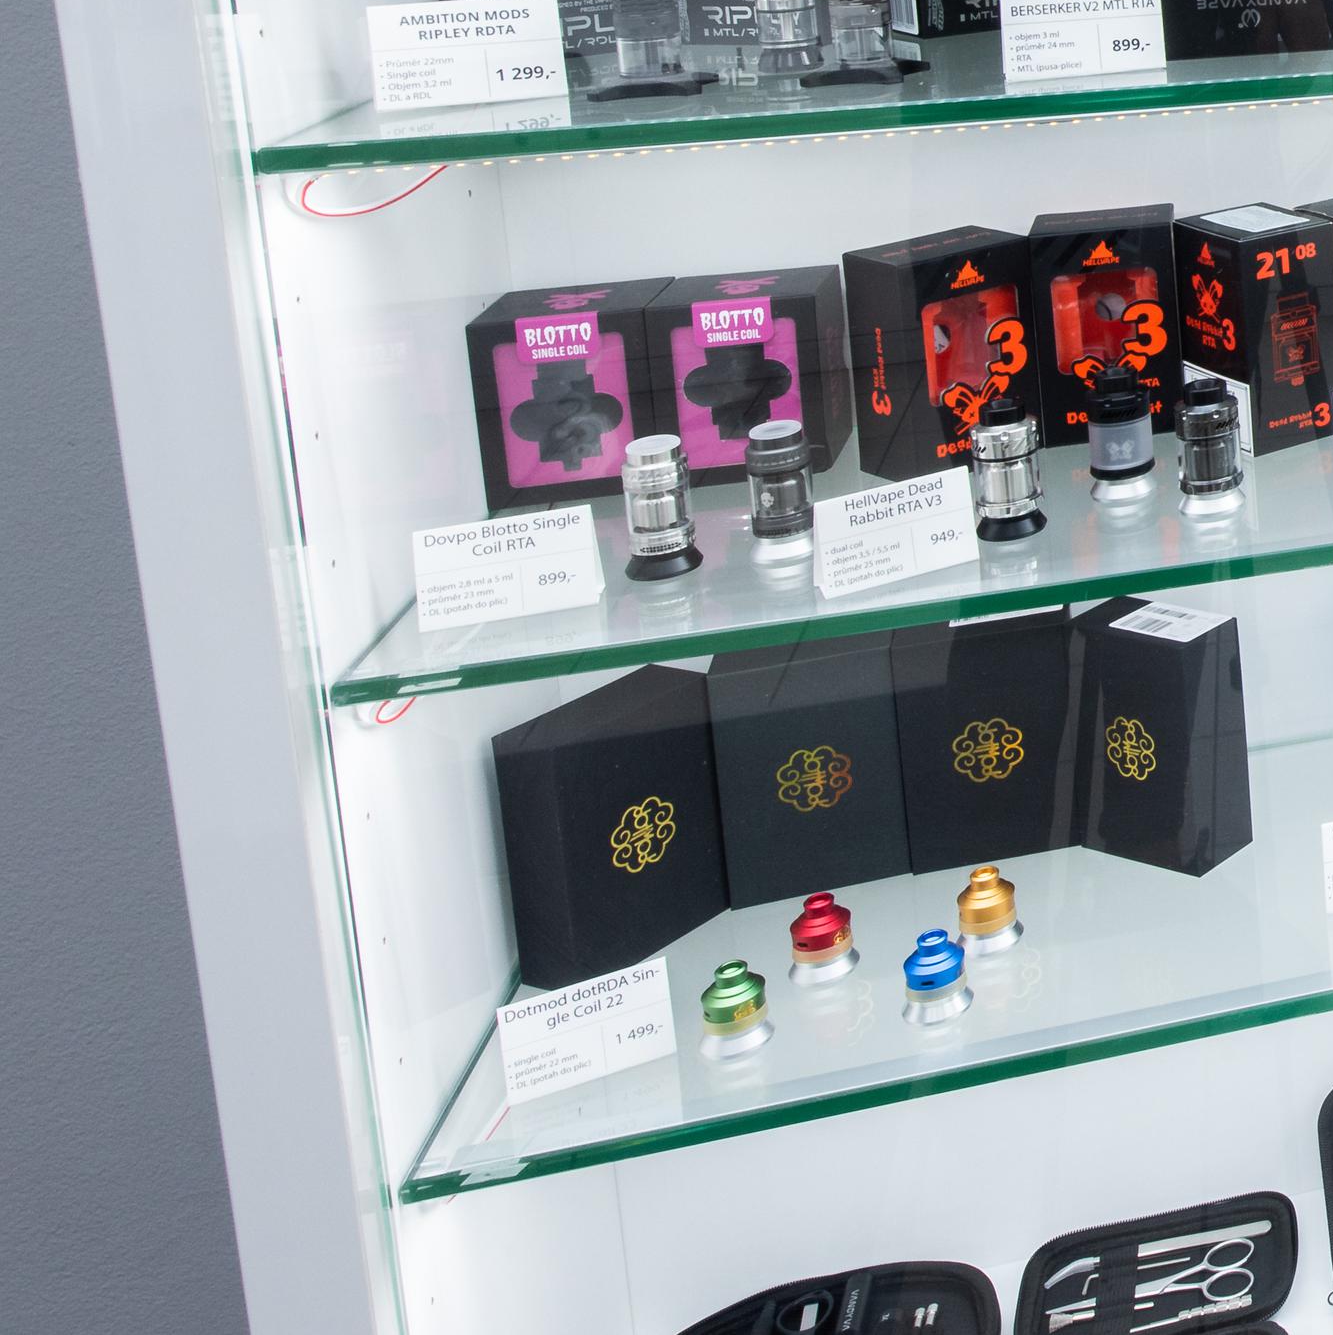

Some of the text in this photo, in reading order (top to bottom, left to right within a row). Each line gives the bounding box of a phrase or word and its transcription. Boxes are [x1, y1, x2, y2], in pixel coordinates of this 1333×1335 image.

[399, 7, 530, 26] AMBITION MODS
[1011, 2, 1082, 18] BERSERKER
[1084, 1, 1099, 14] V2
[1102, 0, 1129, 12] MTL
[418, 23, 516, 41] RIPLEY RDTA
[1112, 37, 1150, 54] 899,-
[496, 65, 556, 82] 1 299,-
[700, 307, 764, 331] BLOTTO
[524, 323, 592, 347] BLOTTO
[707, 329, 760, 343] SINGLE COIL
[532, 344, 588, 360] SINGLE COIL
[844, 478, 943, 513] HellVape Dead
[849, 495, 942, 528] Rabbit RTA V3
[423, 514, 580, 550] Dovpo Blotto Single
[930, 530, 963, 547] 949,-
[472, 537, 536, 558] Coil RTA
[538, 571, 576, 587] 899,-
[505, 968, 660, 1024] Dotmod dotRDA Sin-
[547, 994, 624, 1030] gle Coil 22
[616, 1023, 664, 1044] 1 499,-
